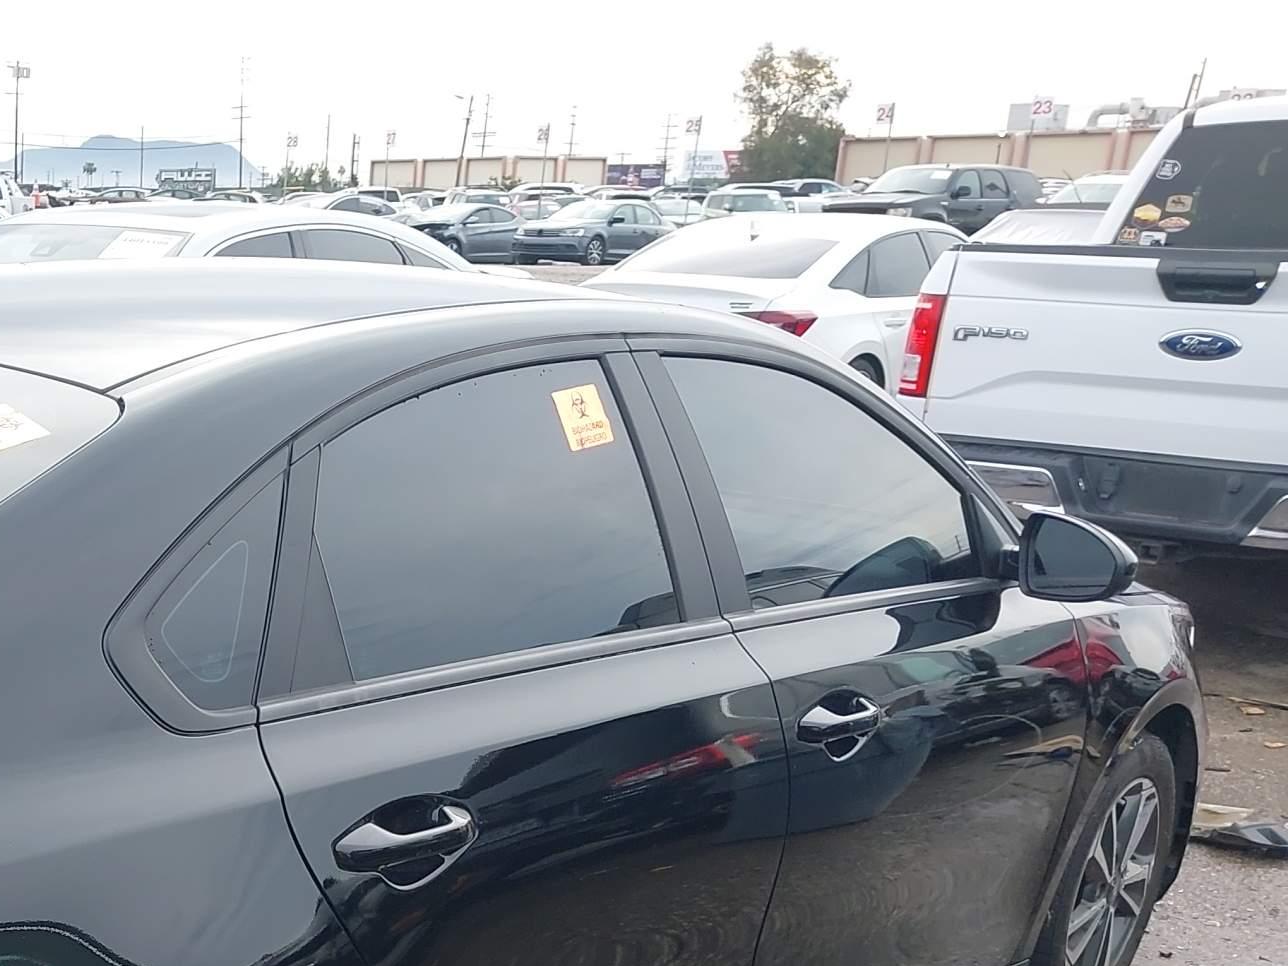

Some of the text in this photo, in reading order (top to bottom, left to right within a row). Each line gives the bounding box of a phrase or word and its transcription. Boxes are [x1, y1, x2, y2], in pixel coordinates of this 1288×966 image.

[876, 106, 894, 124] 24
[1032, 100, 1053, 115] 23
[1176, 334, 1225, 355] Ford
